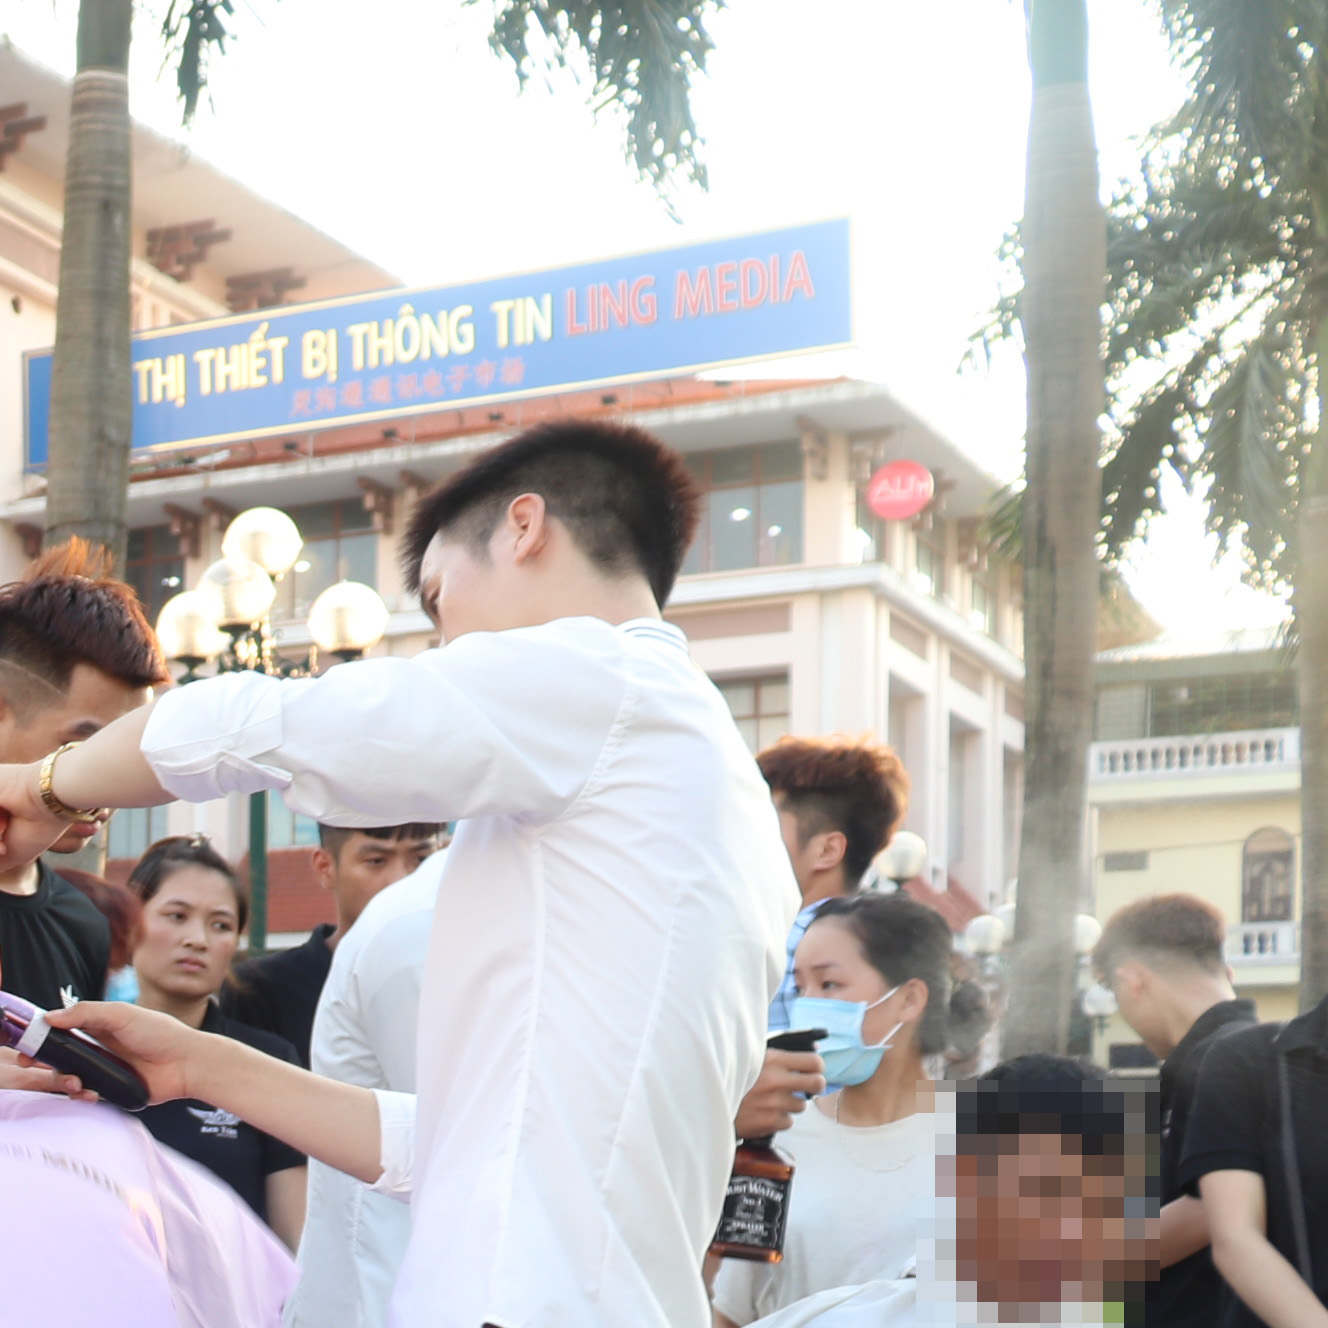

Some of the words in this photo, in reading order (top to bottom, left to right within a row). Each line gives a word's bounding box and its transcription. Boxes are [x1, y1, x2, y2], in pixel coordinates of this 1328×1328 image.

[133, 351, 188, 408] THỊ
[193, 321, 290, 396] THIẾT
[301, 327, 339, 384] BỊ
[346, 302, 477, 372] THÔNG
[489, 292, 553, 350] TIN
[564, 274, 659, 337] LING
[673, 249, 816, 321] MEDIA
